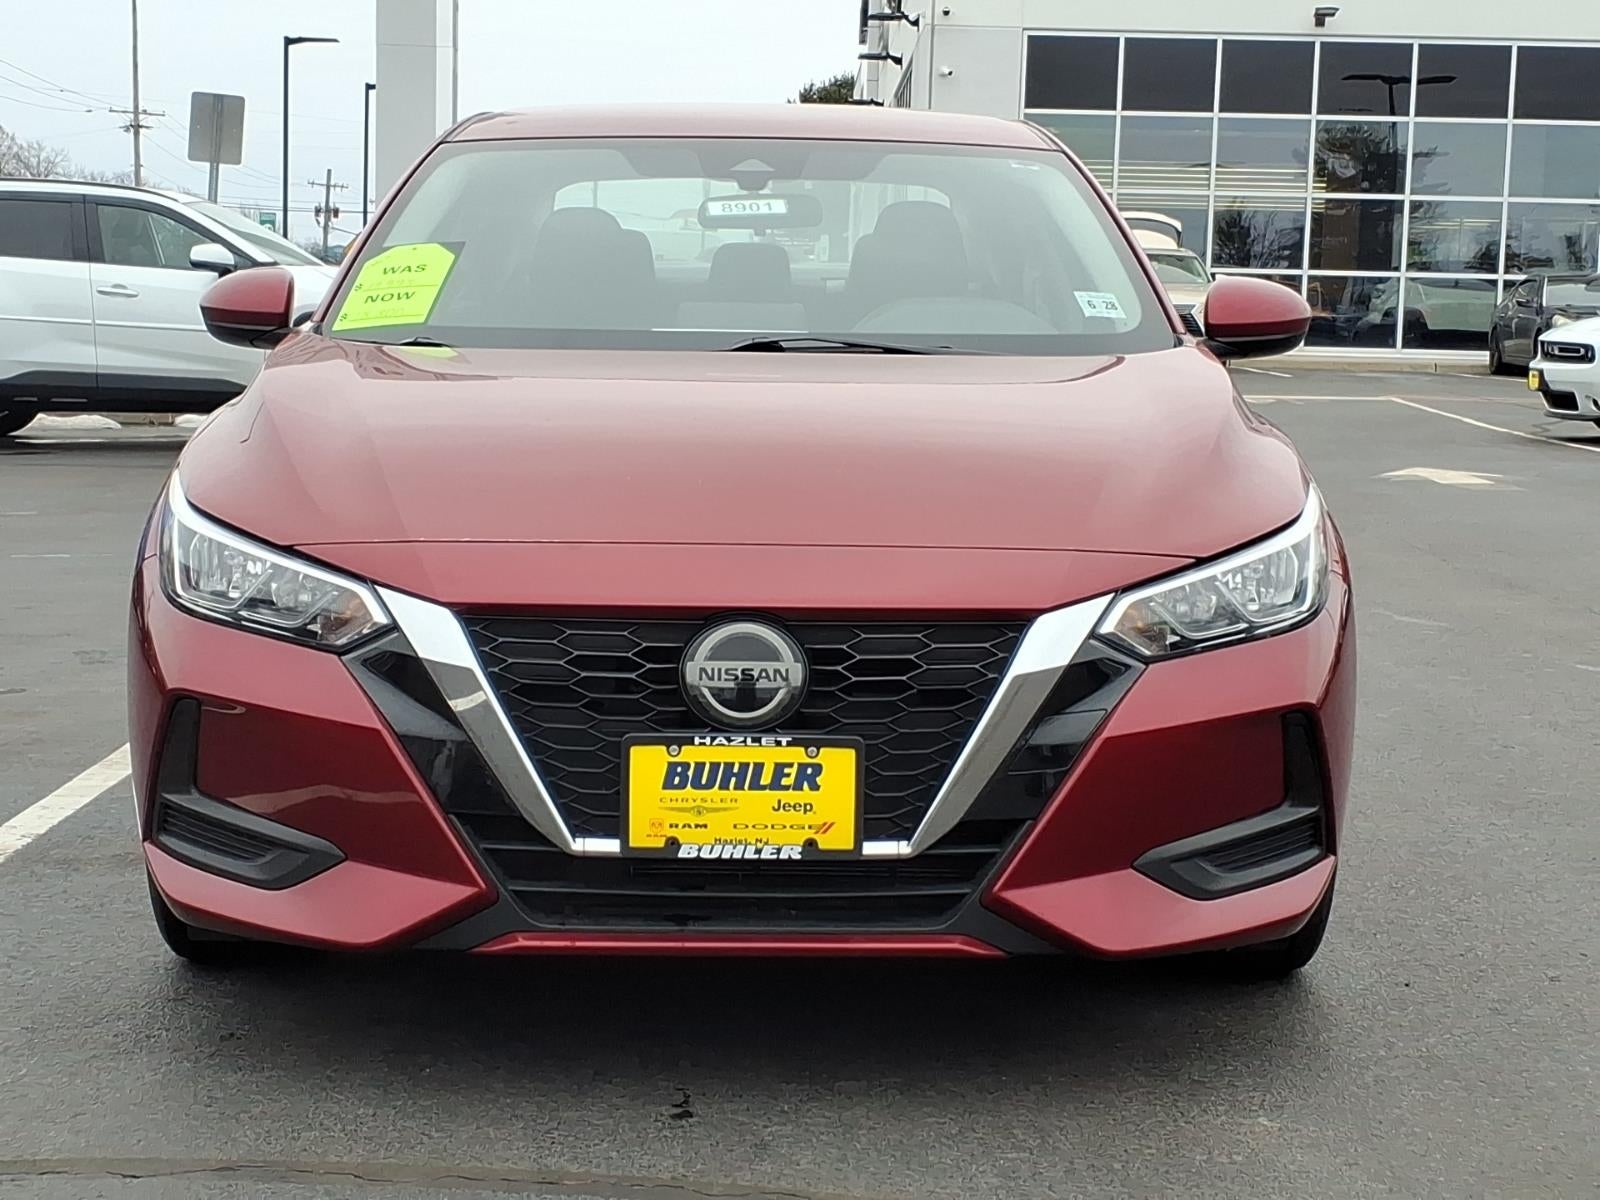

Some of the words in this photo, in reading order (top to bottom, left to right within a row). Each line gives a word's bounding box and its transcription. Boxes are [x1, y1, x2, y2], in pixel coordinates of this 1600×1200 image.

[721, 202, 772, 213] 8901
[383, 264, 427, 275] WAS
[364, 291, 416, 304] NOW
[1087, 300, 1096, 309] 6
[1102, 300, 1118, 310] 28
[698, 667, 790, 682] NISSAN
[694, 736, 792, 747] HAZLET
[661, 761, 823, 792] BUHLER
[659, 796, 738, 804] CHRYSLER
[772, 799, 814, 815] Jeep
[733, 822, 819, 830] DODGE
[677, 844, 802, 859] BUHLER
